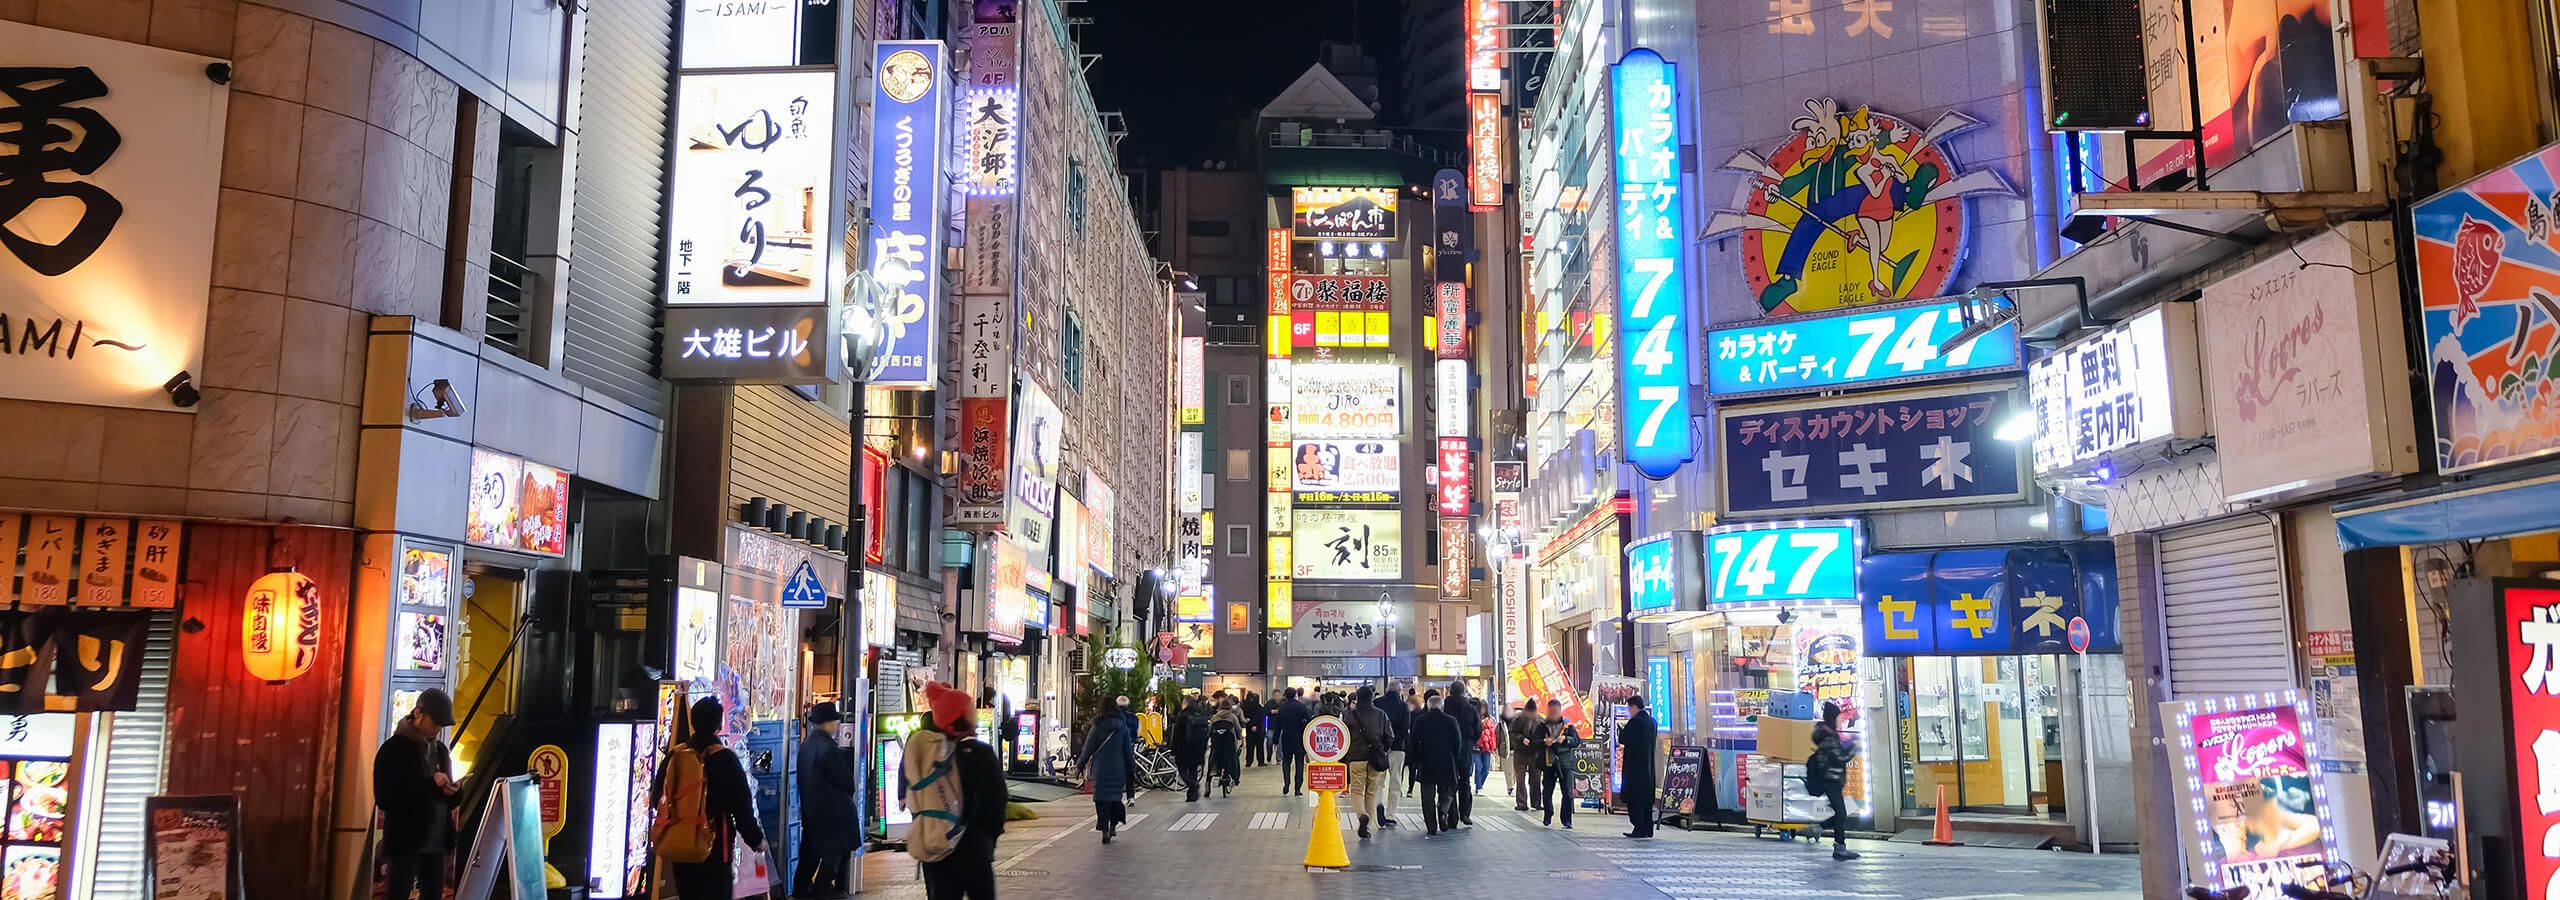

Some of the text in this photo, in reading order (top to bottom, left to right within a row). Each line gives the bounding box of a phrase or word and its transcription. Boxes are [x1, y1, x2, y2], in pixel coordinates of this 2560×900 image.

[979, 26, 1010, 36] アロハ
[982, 73, 1005, 86] 4F
[894, 115, 914, 221] くつろぎの里
[1619, 127, 1646, 240] パーティ
[1305, 205, 1386, 231] にっぽん市
[677, 239, 693, 295] 地下一階
[1811, 261, 1837, 272] EAGLE
[1812, 250, 1839, 261] SOUND
[1839, 283, 1860, 293] LADY
[1839, 291, 1864, 303] EAGLE
[2250, 271, 2298, 303] メンズエステ
[682, 325, 809, 360] 大雄ビル
[1293, 323, 1311, 335] 6F
[1718, 329, 1798, 361] カラオケ
[1844, 304, 1987, 379] 747
[872, 355, 922, 366] 西口店
[1630, 257, 1679, 448] 747
[1758, 354, 1838, 385] パーティ
[2080, 337, 2121, 398] 無料
[2296, 369, 2343, 409] ラバーズ
[1739, 397, 1998, 447] ディスカウントショップ
[2075, 392, 2138, 457] 案内所
[1495, 476, 1521, 491] Style
[1762, 435, 1974, 502] セキネ
[1021, 467, 1055, 518] ROSA
[41, 519, 63, 571] レバー
[95, 523, 116, 572] ねぎま
[145, 526, 168, 563] 砂肝
[1181, 516, 1200, 560] 焼肉
[1323, 524, 1370, 569] 刻
[1297, 564, 1315, 577] 3F
[1715, 531, 1839, 599] 747
[32, 587, 57, 600] 180
[88, 588, 112, 602] 180
[143, 589, 165, 602] 150
[1505, 581, 1516, 636] KOSHIEN
[296, 582, 318, 670] やきとり
[1878, 590, 2066, 641] セキネ
[1671, 776, 1691, 788] 0分
